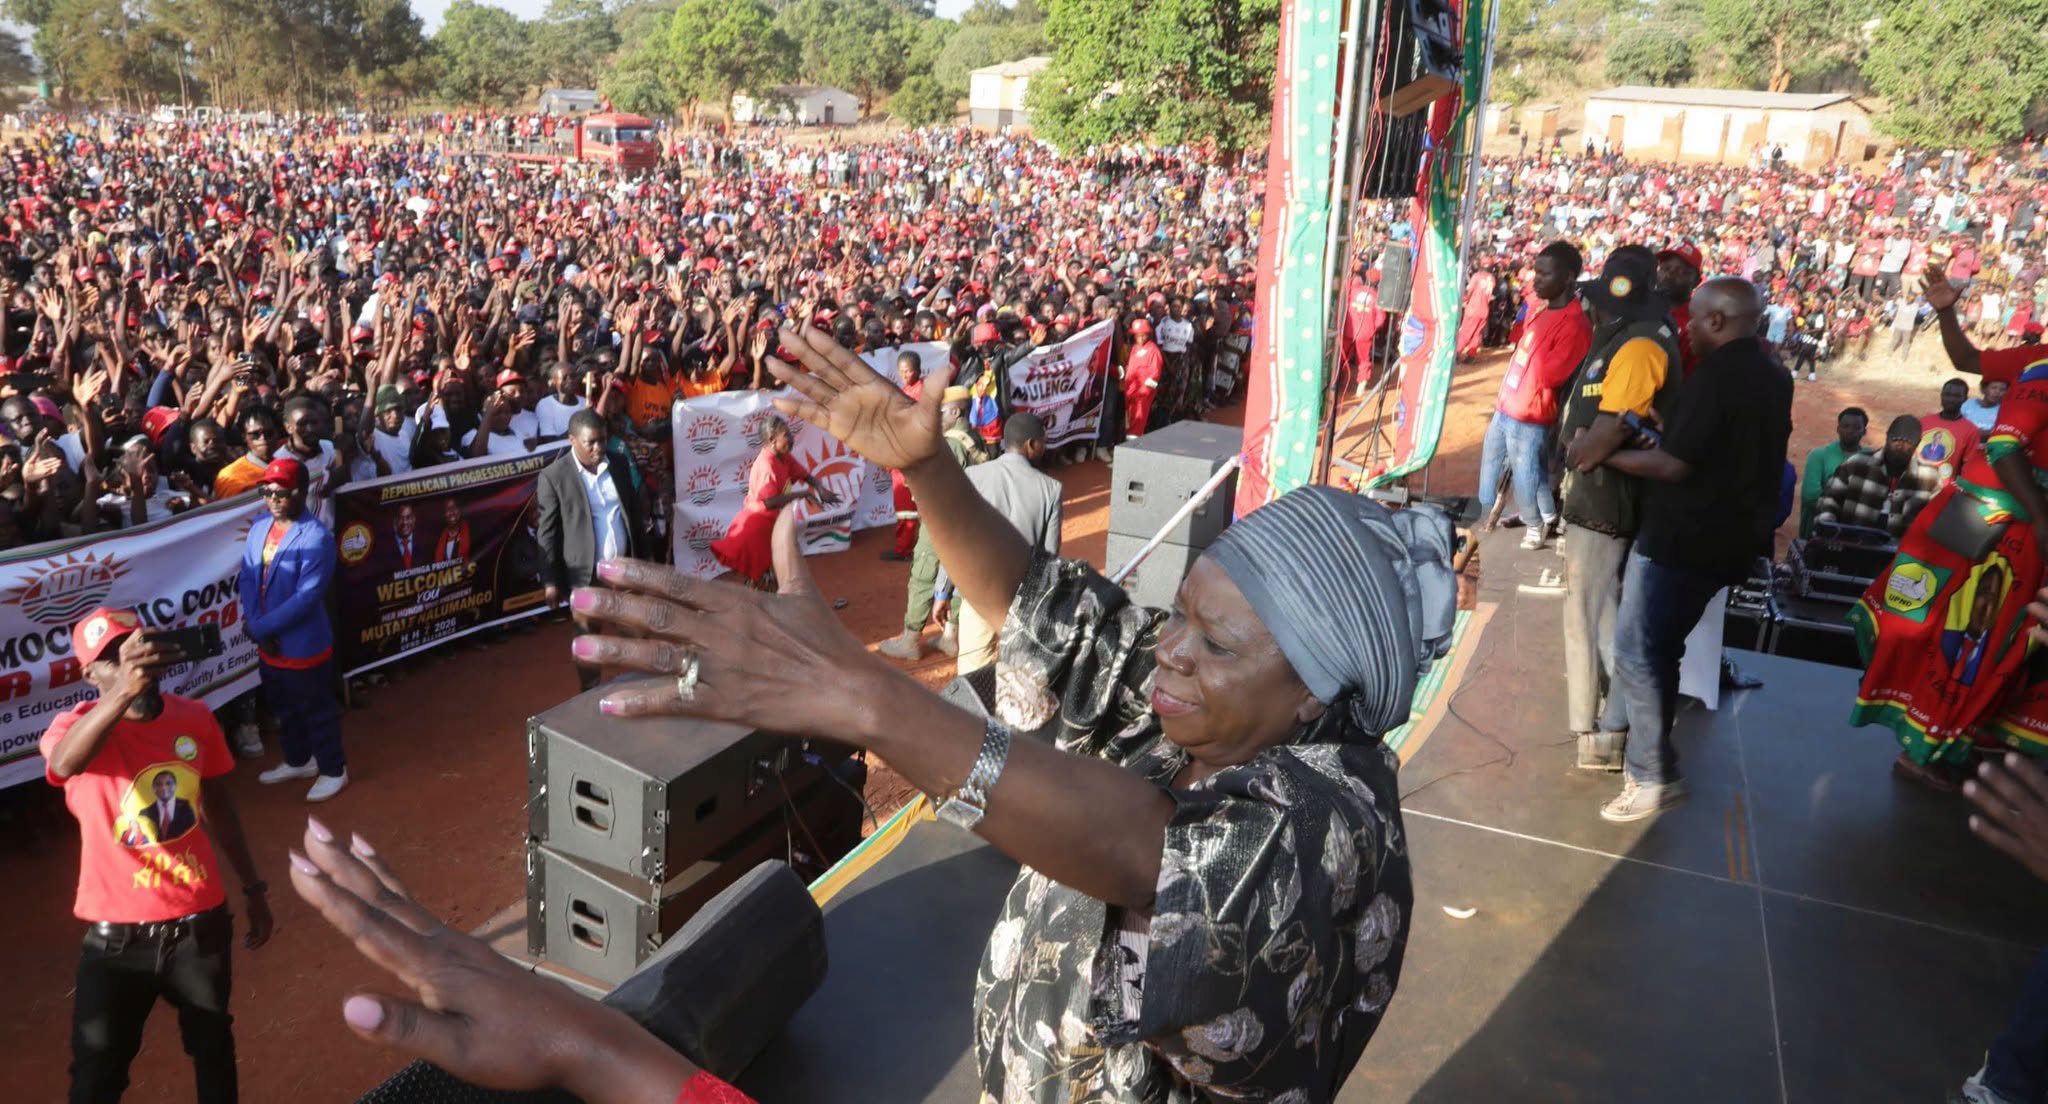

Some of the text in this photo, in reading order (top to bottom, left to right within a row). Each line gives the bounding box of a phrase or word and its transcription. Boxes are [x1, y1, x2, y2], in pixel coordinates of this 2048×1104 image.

[1012, 377, 1078, 402] MULENGA
[381, 455, 545, 501] REPUBLICAN PROGRESSIVE PARTY
[182, 572, 241, 616] CON
[416, 587, 441, 604] YOU
[417, 589, 493, 624] NALUMANGO
